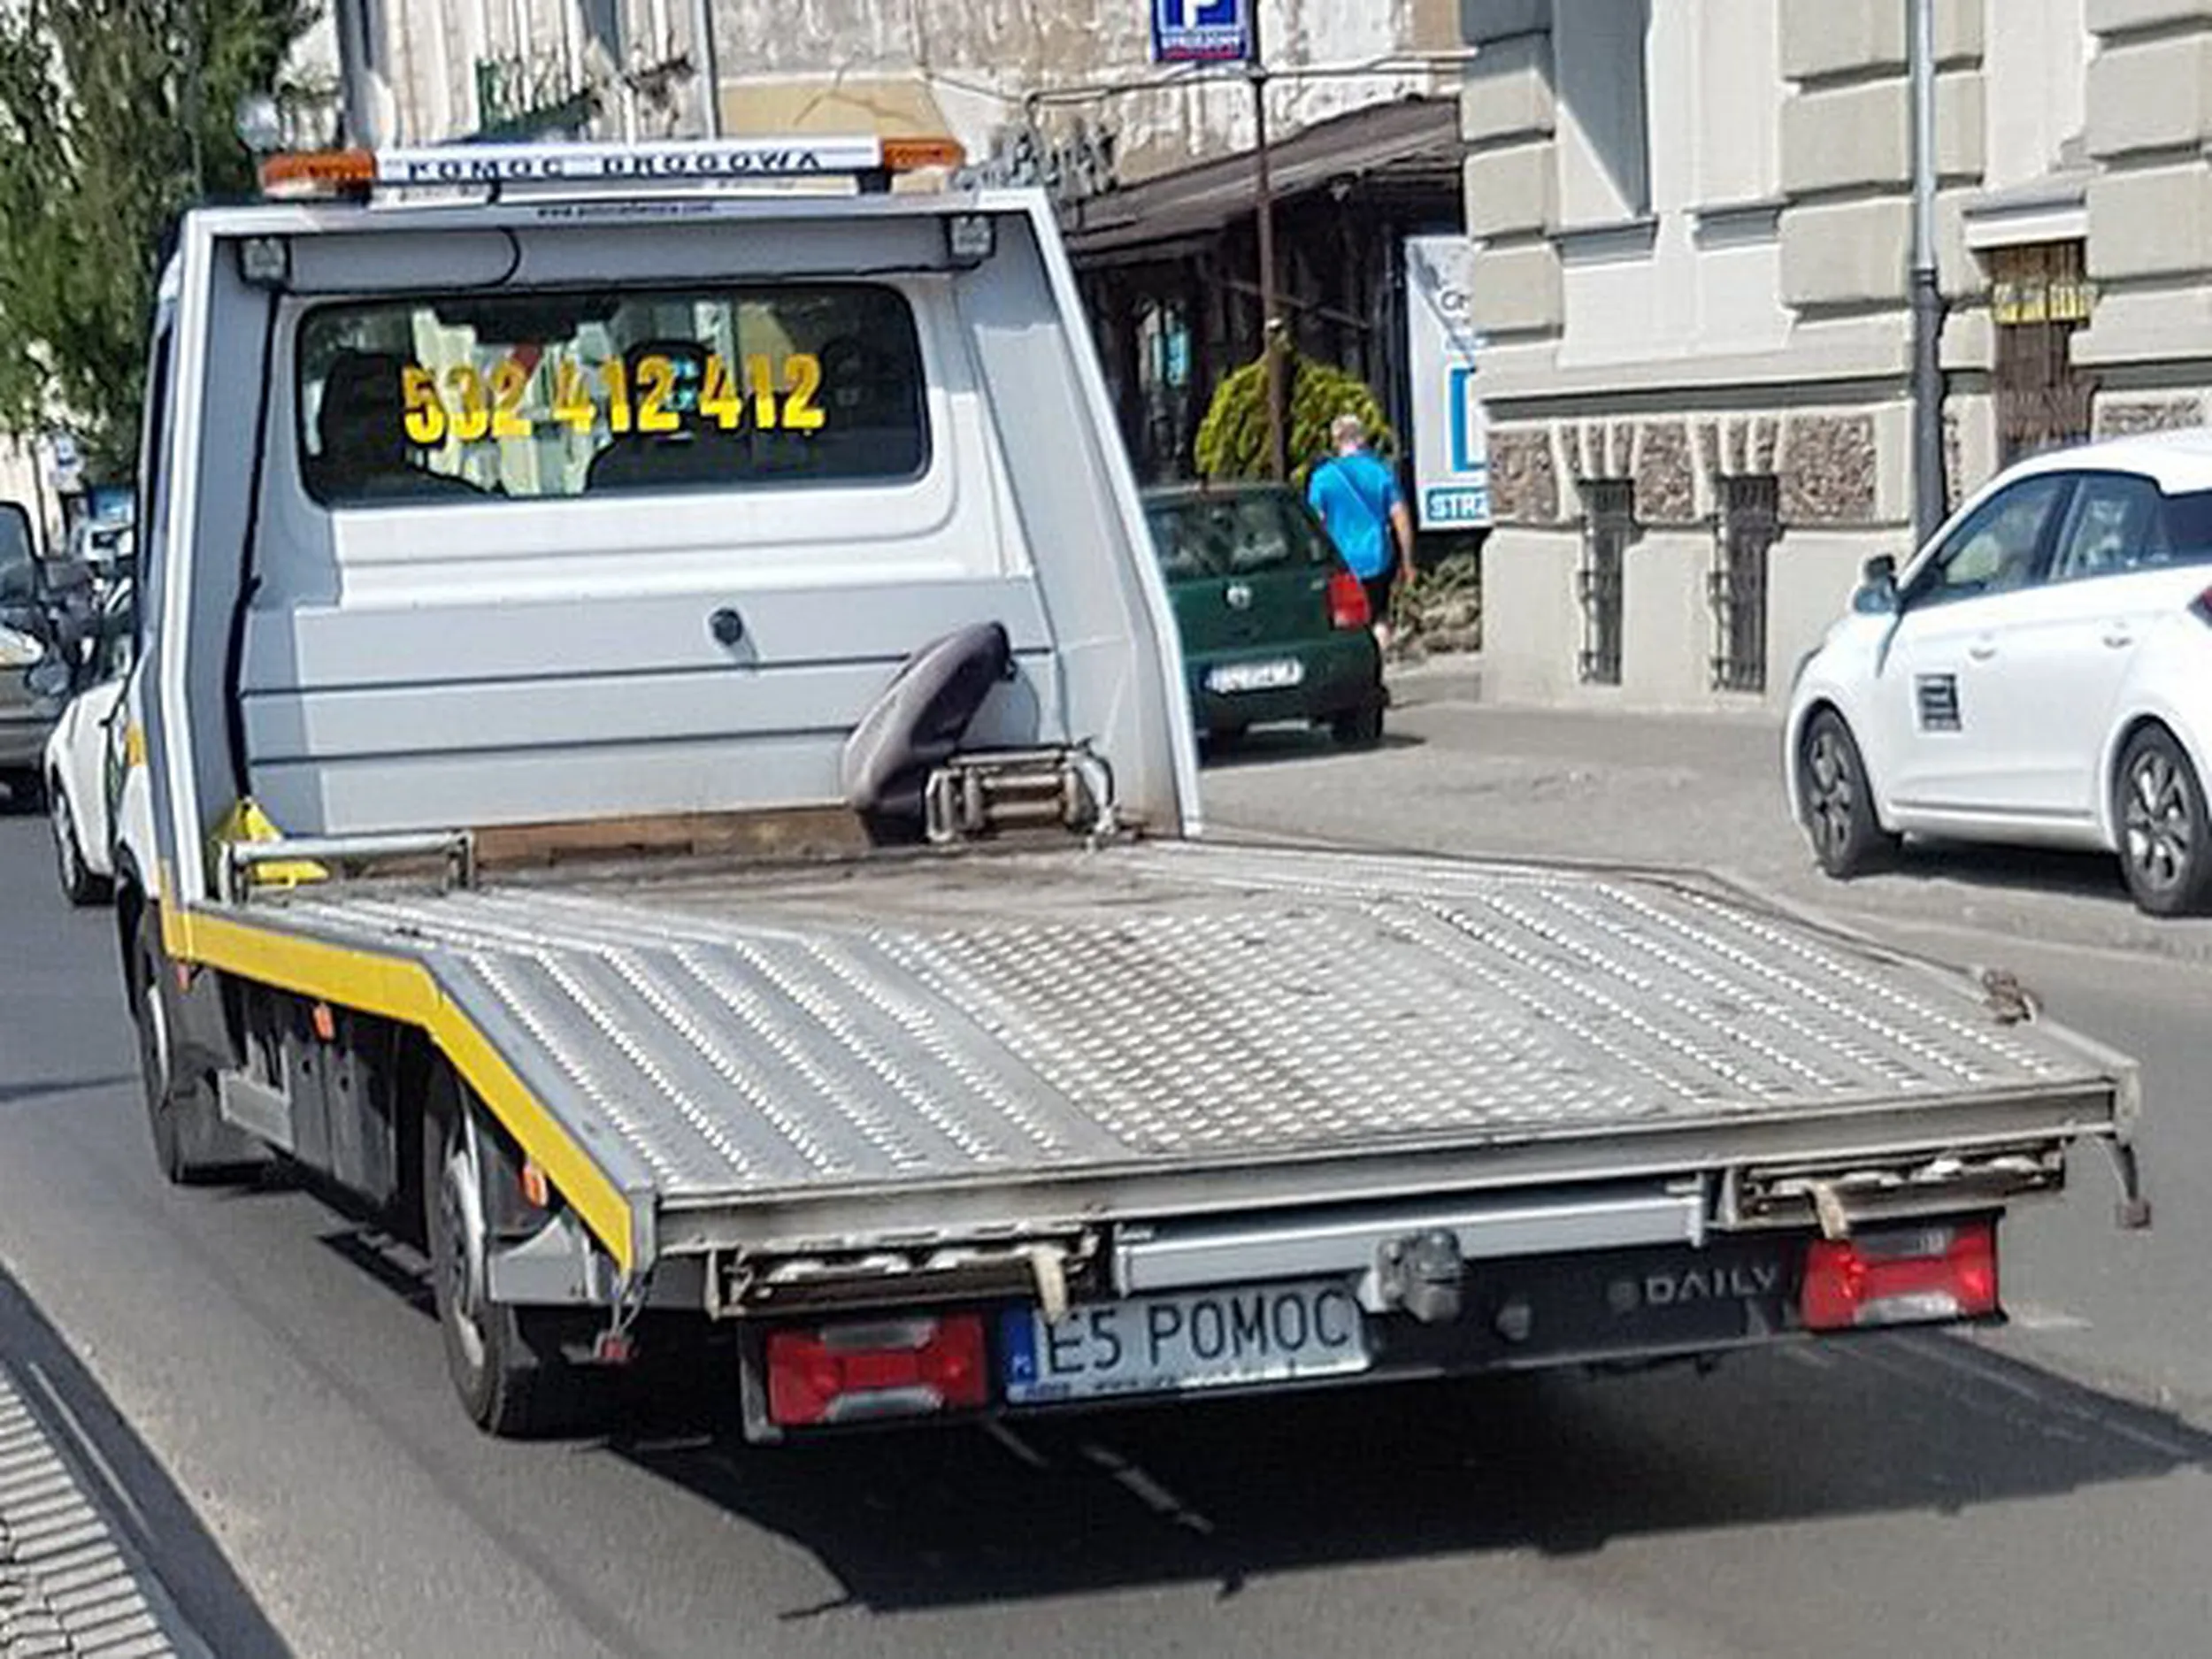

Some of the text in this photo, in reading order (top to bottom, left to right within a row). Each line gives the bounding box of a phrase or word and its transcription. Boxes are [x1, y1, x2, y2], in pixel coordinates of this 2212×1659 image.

[552, 356, 680, 432] 412
[699, 354, 826, 431] 412
[1647, 1265, 1777, 1303] DAILY
[1149, 1288, 1349, 1366] POMOC
